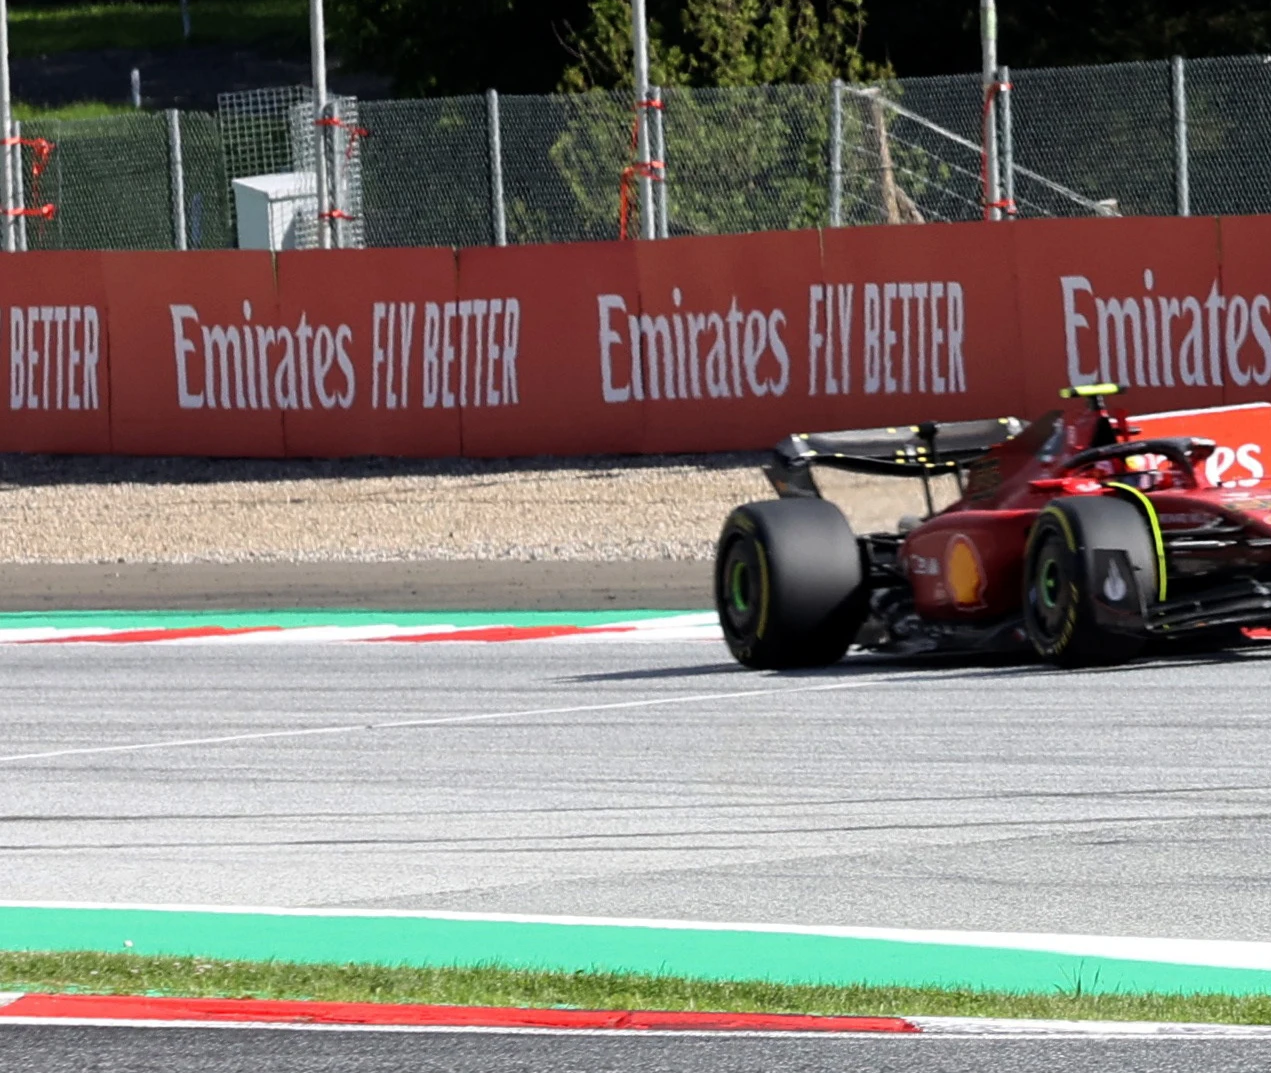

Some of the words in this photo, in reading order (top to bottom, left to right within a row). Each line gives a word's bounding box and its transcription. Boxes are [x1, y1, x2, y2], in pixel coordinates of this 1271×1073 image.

[11, 306, 99, 409] BETTER
[170, 300, 354, 408] Emirates
[373, 303, 415, 408] FLY
[424, 298, 519, 407] BETTER
[598, 288, 789, 402] Emirates
[810, 284, 853, 394] FLY
[865, 282, 965, 392] BETTER
